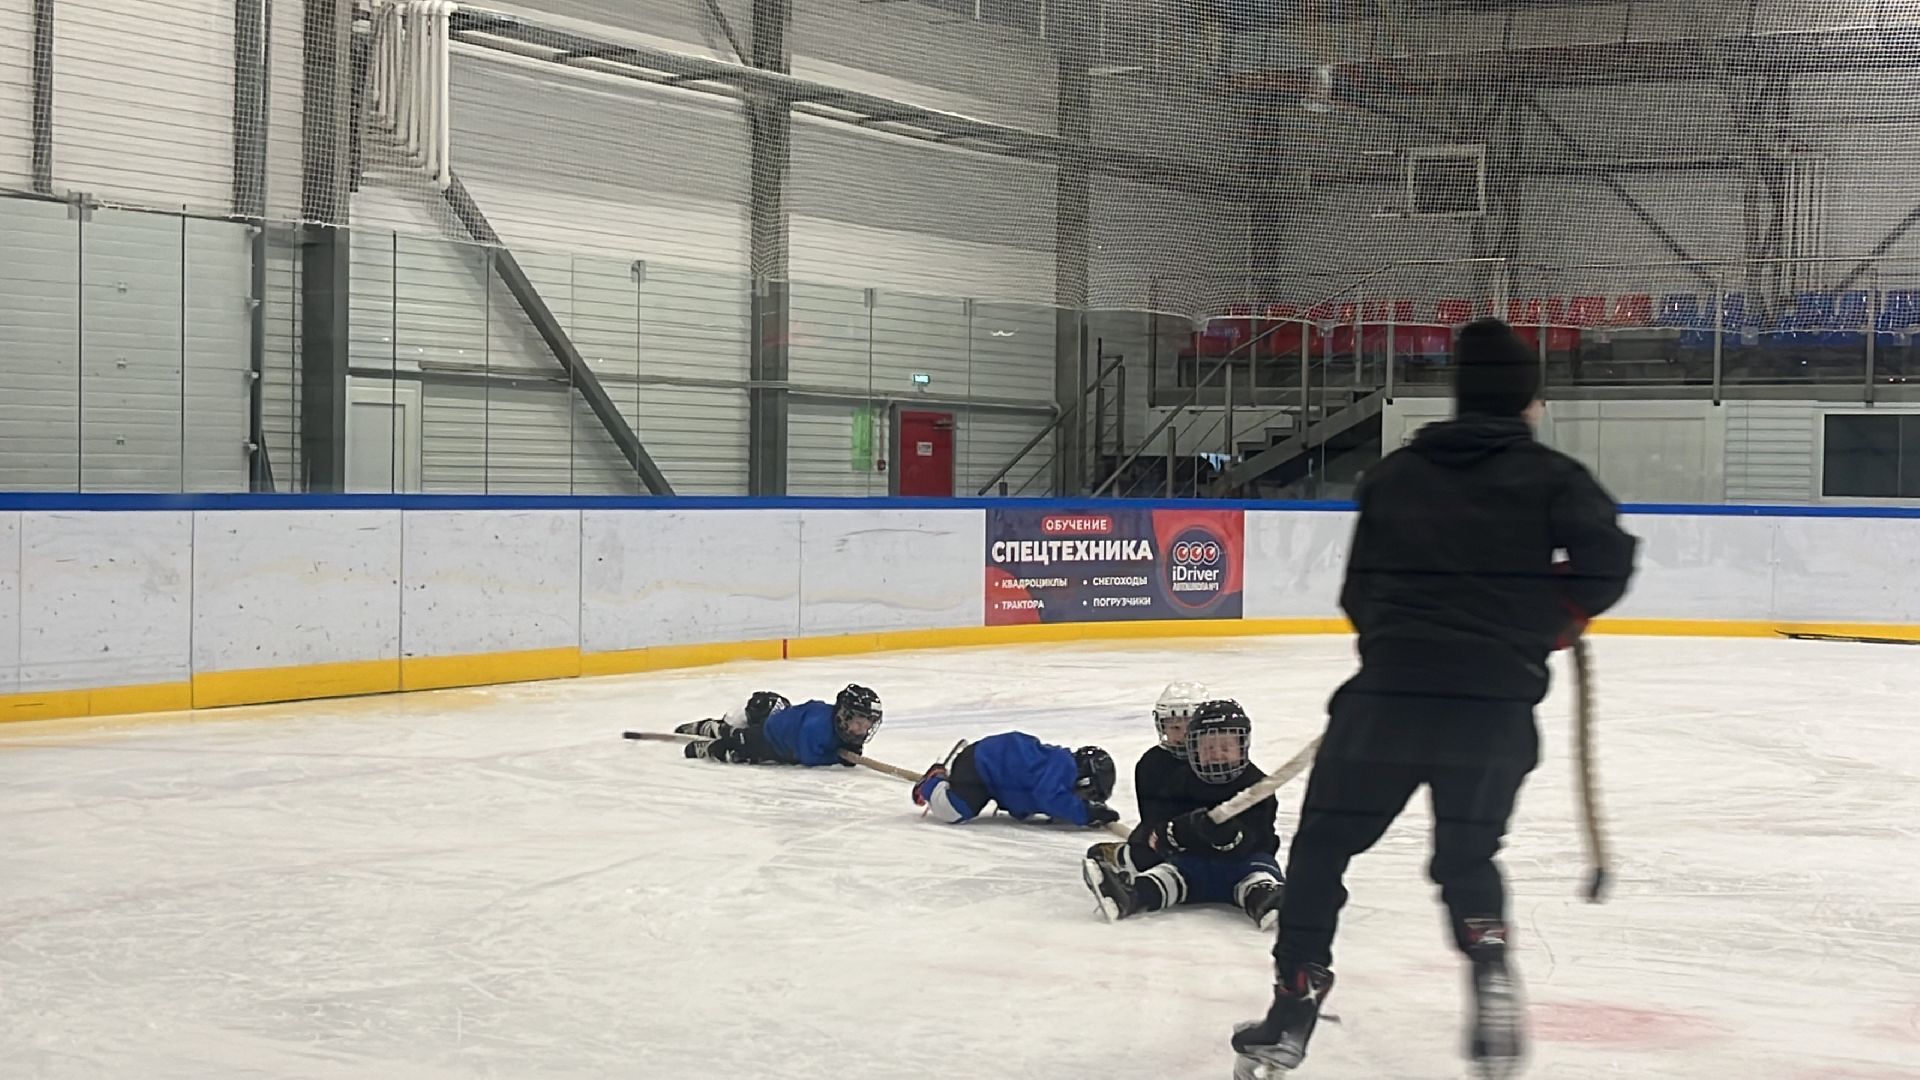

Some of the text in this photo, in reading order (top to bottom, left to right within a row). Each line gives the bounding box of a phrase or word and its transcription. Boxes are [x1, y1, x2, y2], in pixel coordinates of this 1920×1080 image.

[1045, 519, 1107, 531] ОБУЧЕНИЕ
[991, 540, 1154, 565] СПЕЦТЕХНИКА
[1172, 566, 1219, 581] iDriver
[1001, 578, 1068, 589] КВАДРОЦИКЛЫ
[1092, 576, 1148, 587] СНЕГОХОДЫ
[1001, 600, 1045, 610] ТРАКТОРА
[1093, 597, 1151, 607] ПОГРУЗЧИКИ
